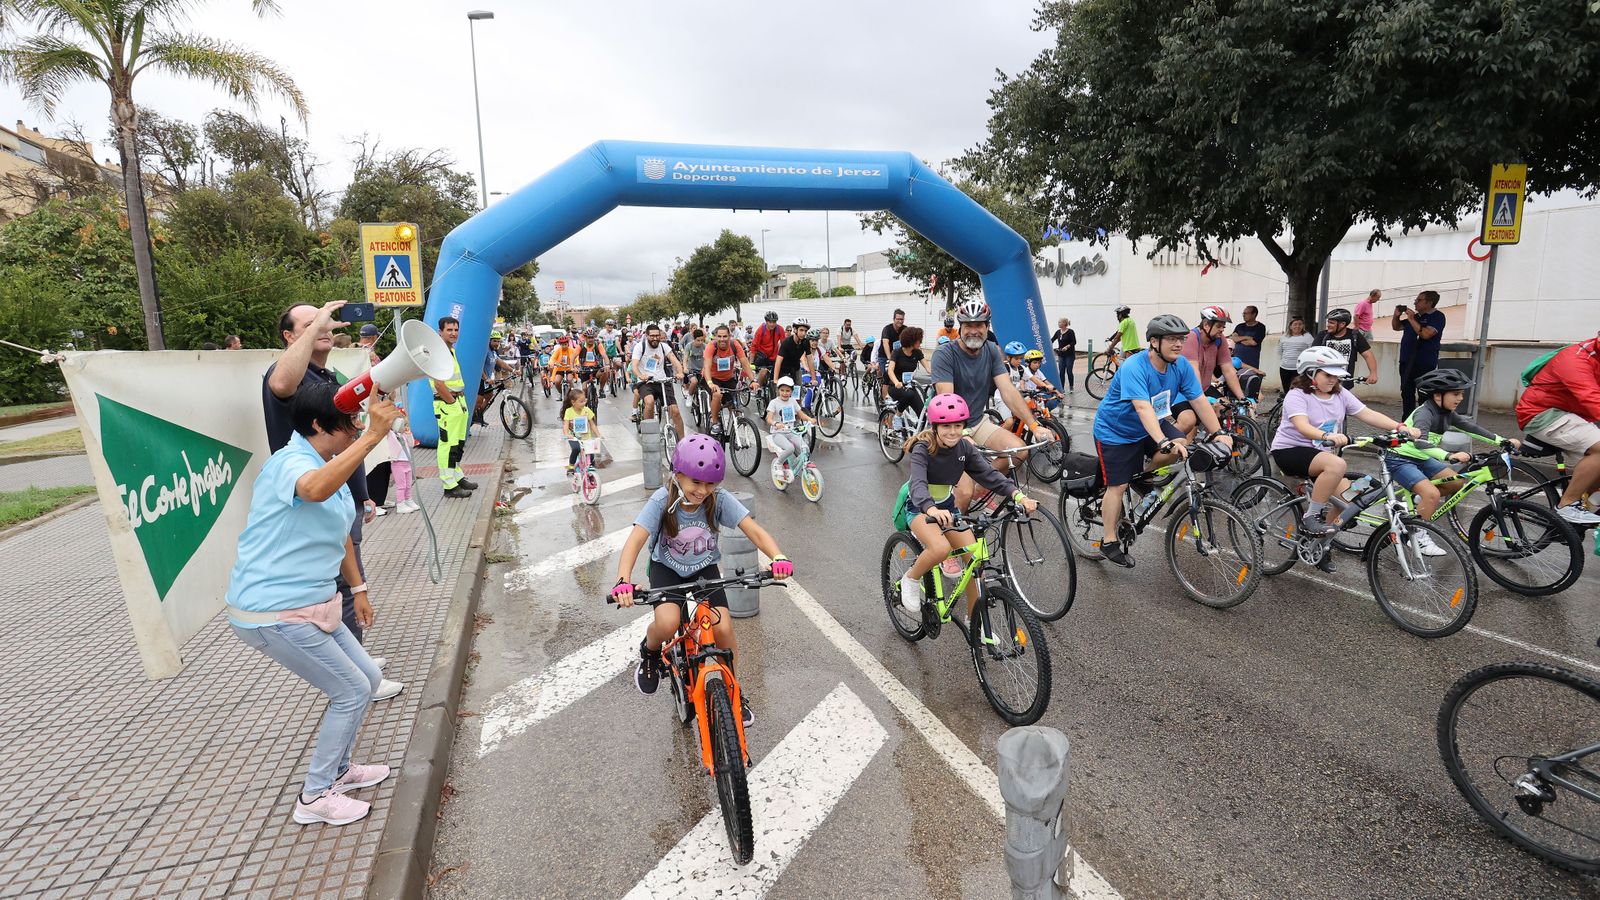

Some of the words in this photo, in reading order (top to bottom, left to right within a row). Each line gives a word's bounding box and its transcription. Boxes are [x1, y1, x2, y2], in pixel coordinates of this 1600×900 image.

[673, 161, 807, 175] Ayuntamiento
[811, 166, 833, 175] de
[836, 167, 881, 178] Jerez
[673, 172, 737, 182] Deportes
[1488, 229, 1516, 241] PEATONES
[374, 291, 417, 303] PEATONES
[140, 472, 190, 523] Corte
[181, 449, 232, 517] Inglés
[690, 564, 700, 572] TO
